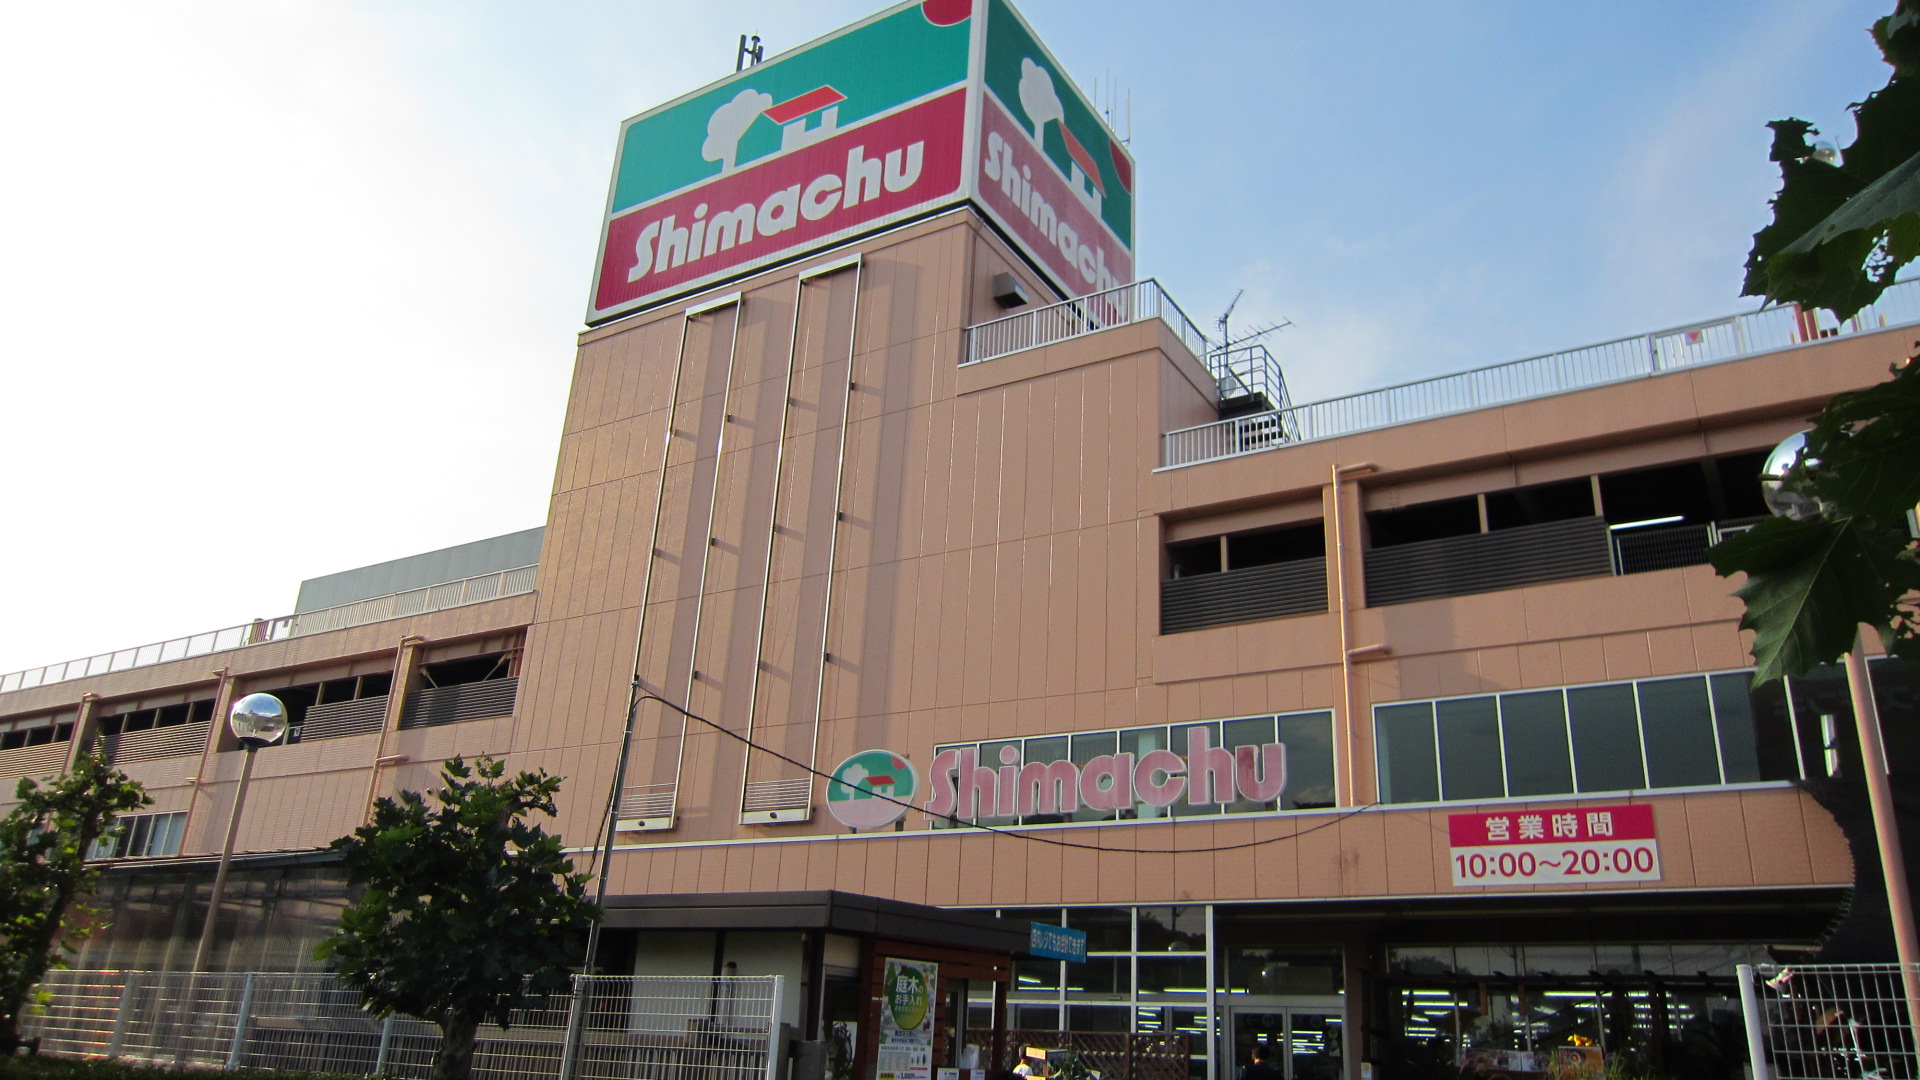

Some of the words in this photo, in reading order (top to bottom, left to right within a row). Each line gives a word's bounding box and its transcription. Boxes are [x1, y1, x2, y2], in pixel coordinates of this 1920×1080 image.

[627, 140, 924, 283] Shimachu
[924, 726, 1287, 821] Shimachu
[1485, 811, 1613, 841] 営業時間
[896, 975, 924, 994] 庭木の
[895, 994, 923, 1006] お手入れ
